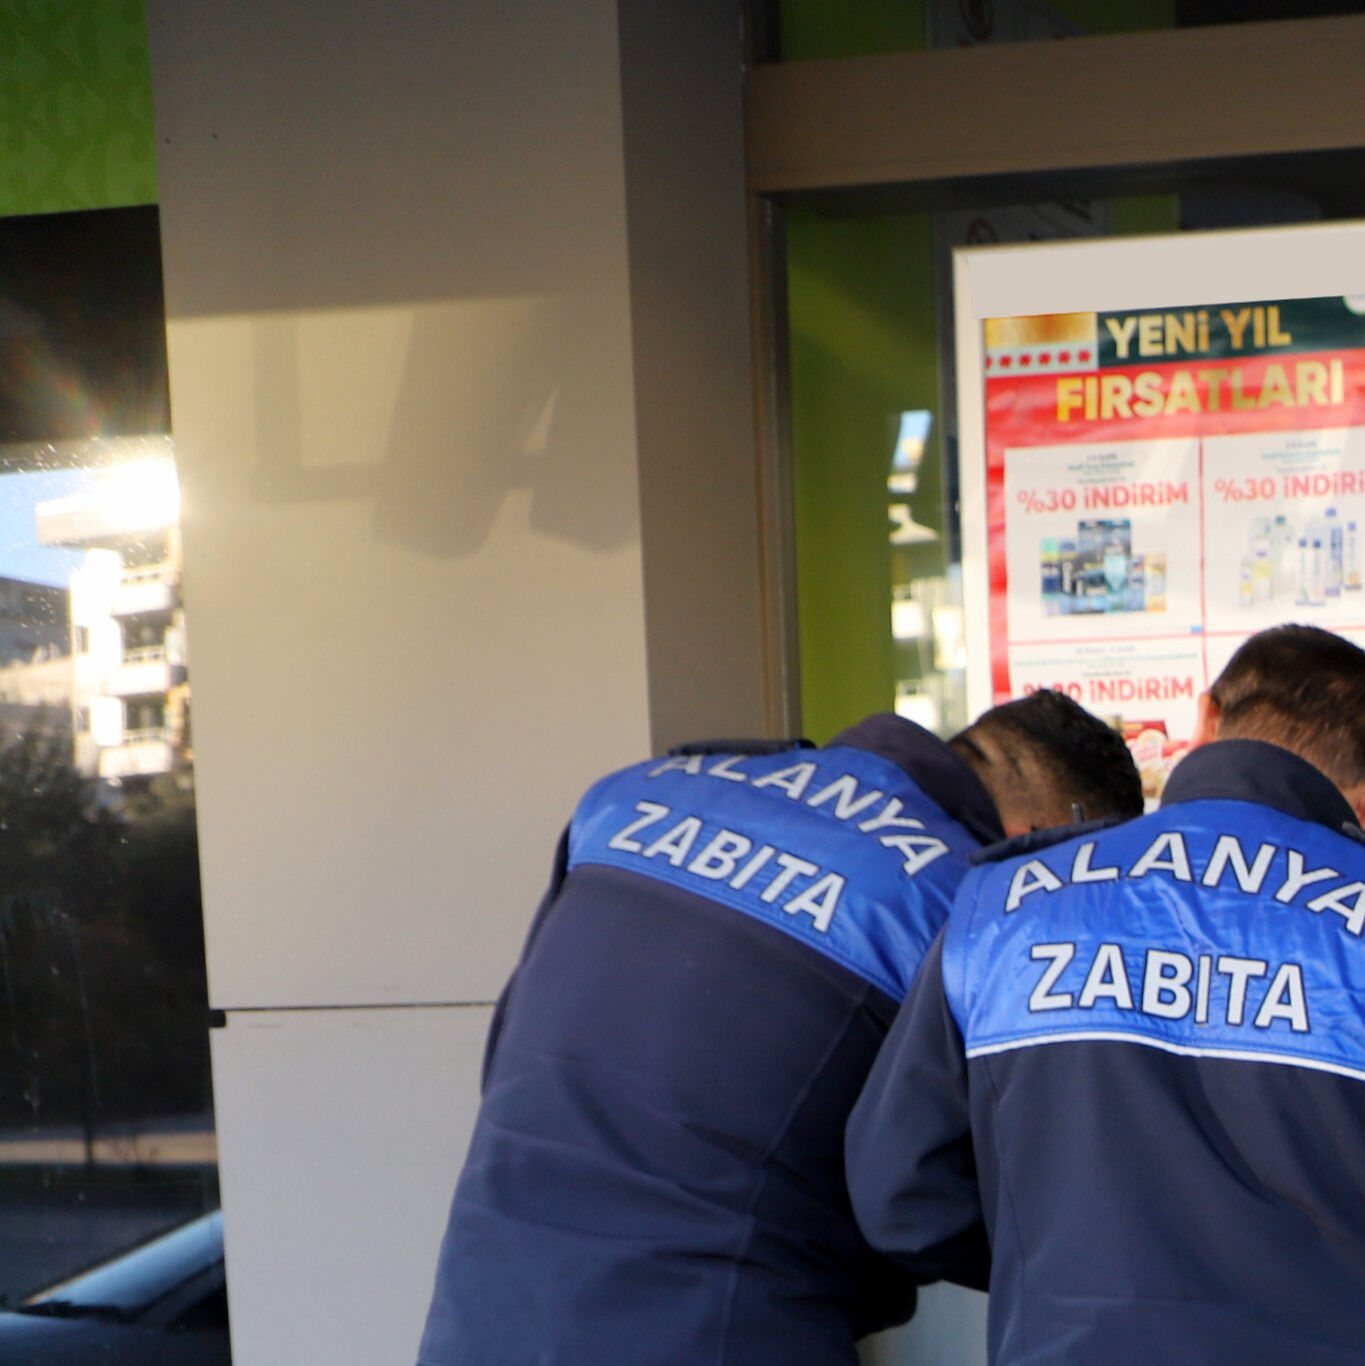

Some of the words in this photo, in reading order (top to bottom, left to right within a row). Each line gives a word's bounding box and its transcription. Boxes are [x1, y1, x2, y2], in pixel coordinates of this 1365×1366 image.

[1221, 306, 1292, 348] YIL
[1056, 358, 1344, 423] FIRSATLARI
[1016, 488, 1077, 513] %30
[1213, 478, 1276, 502] %30
[647, 753, 950, 877] ALANYA
[607, 800, 847, 934] ZABITA
[1028, 943, 1310, 1032] ZABITA
